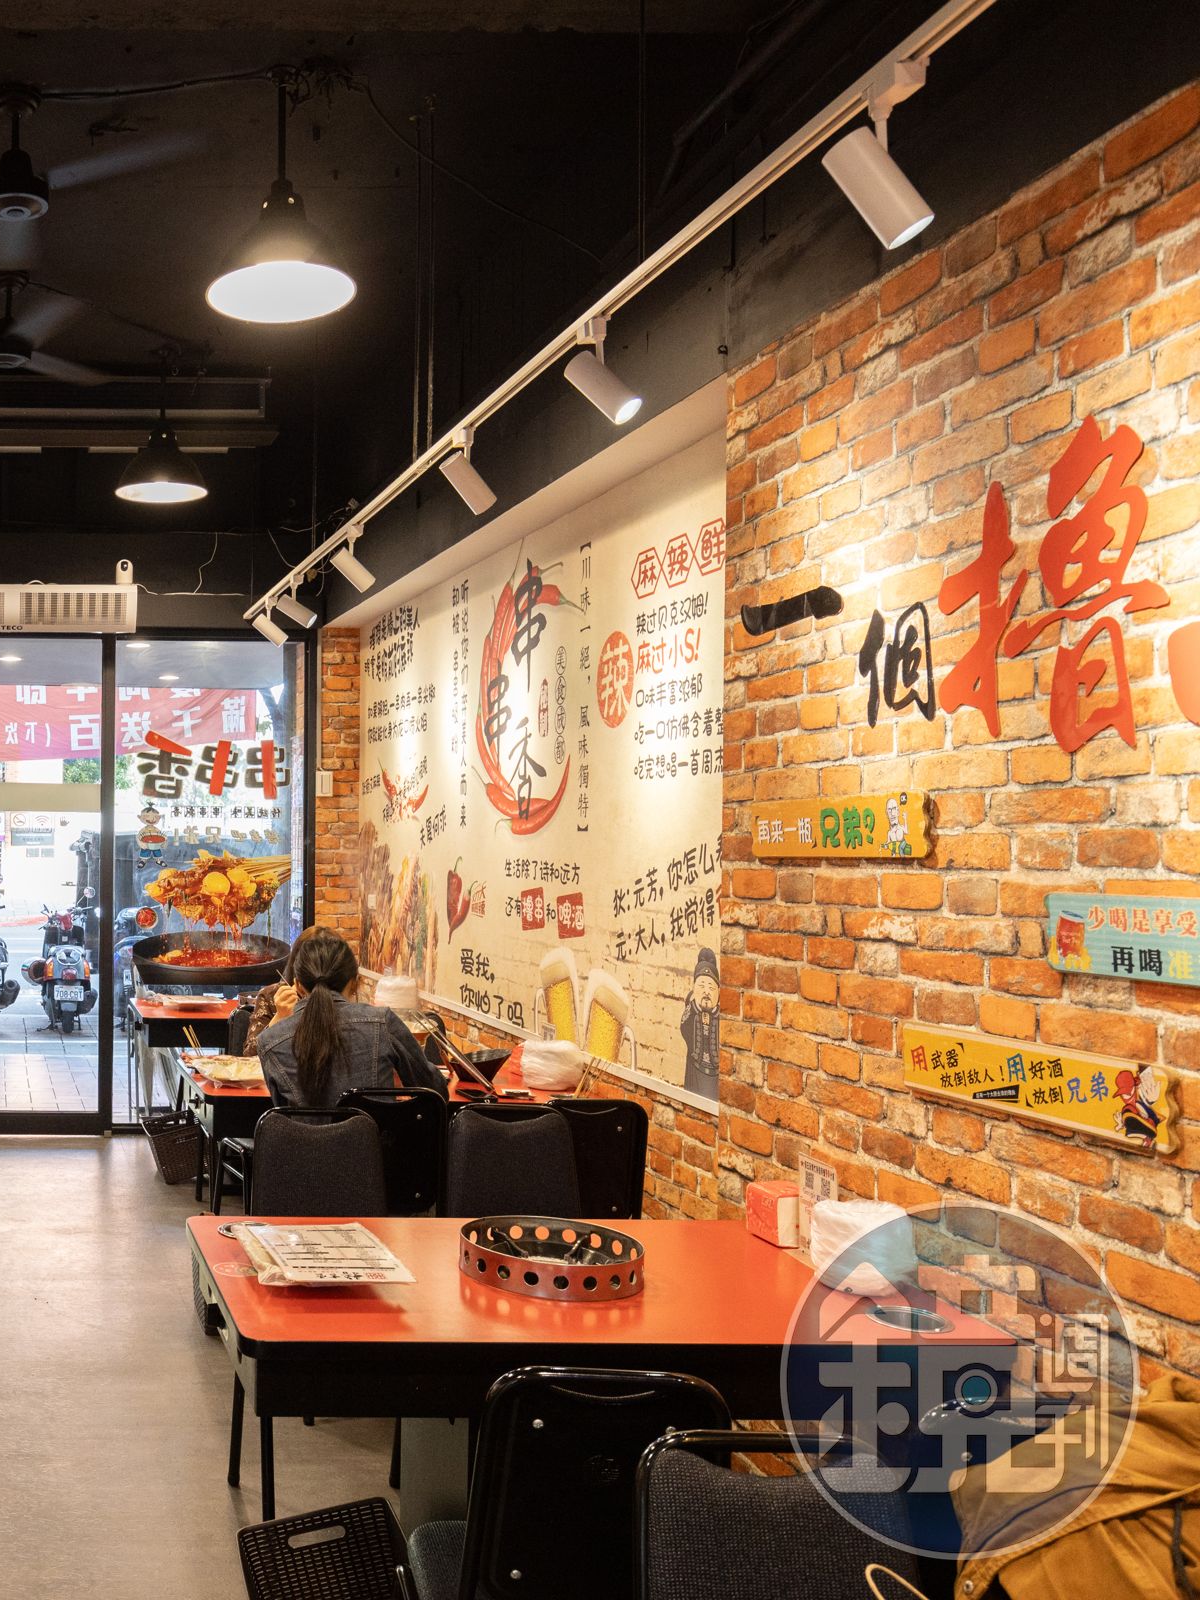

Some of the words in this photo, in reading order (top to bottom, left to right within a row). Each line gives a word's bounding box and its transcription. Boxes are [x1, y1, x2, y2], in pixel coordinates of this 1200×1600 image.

[634, 525, 726, 592] 麻辣鲜
[740, 415, 1200, 755] 一個擼
[484, 558, 547, 820] 串串香
[601, 640, 630, 718] 辣
[635, 673, 703, 708] 口味丰富浓郁
[757, 816, 814, 845] 再来一瓶
[820, 806, 875, 849] 兄弟？
[504, 858, 581, 885] 生活除了诗和远方
[615, 885, 722, 961] 元：大人，我觉得
[1087, 905, 1198, 939] 少喝是享受
[1111, 945, 1200, 979] 再喝准
[459, 985, 524, 1029] 你怕了吗
